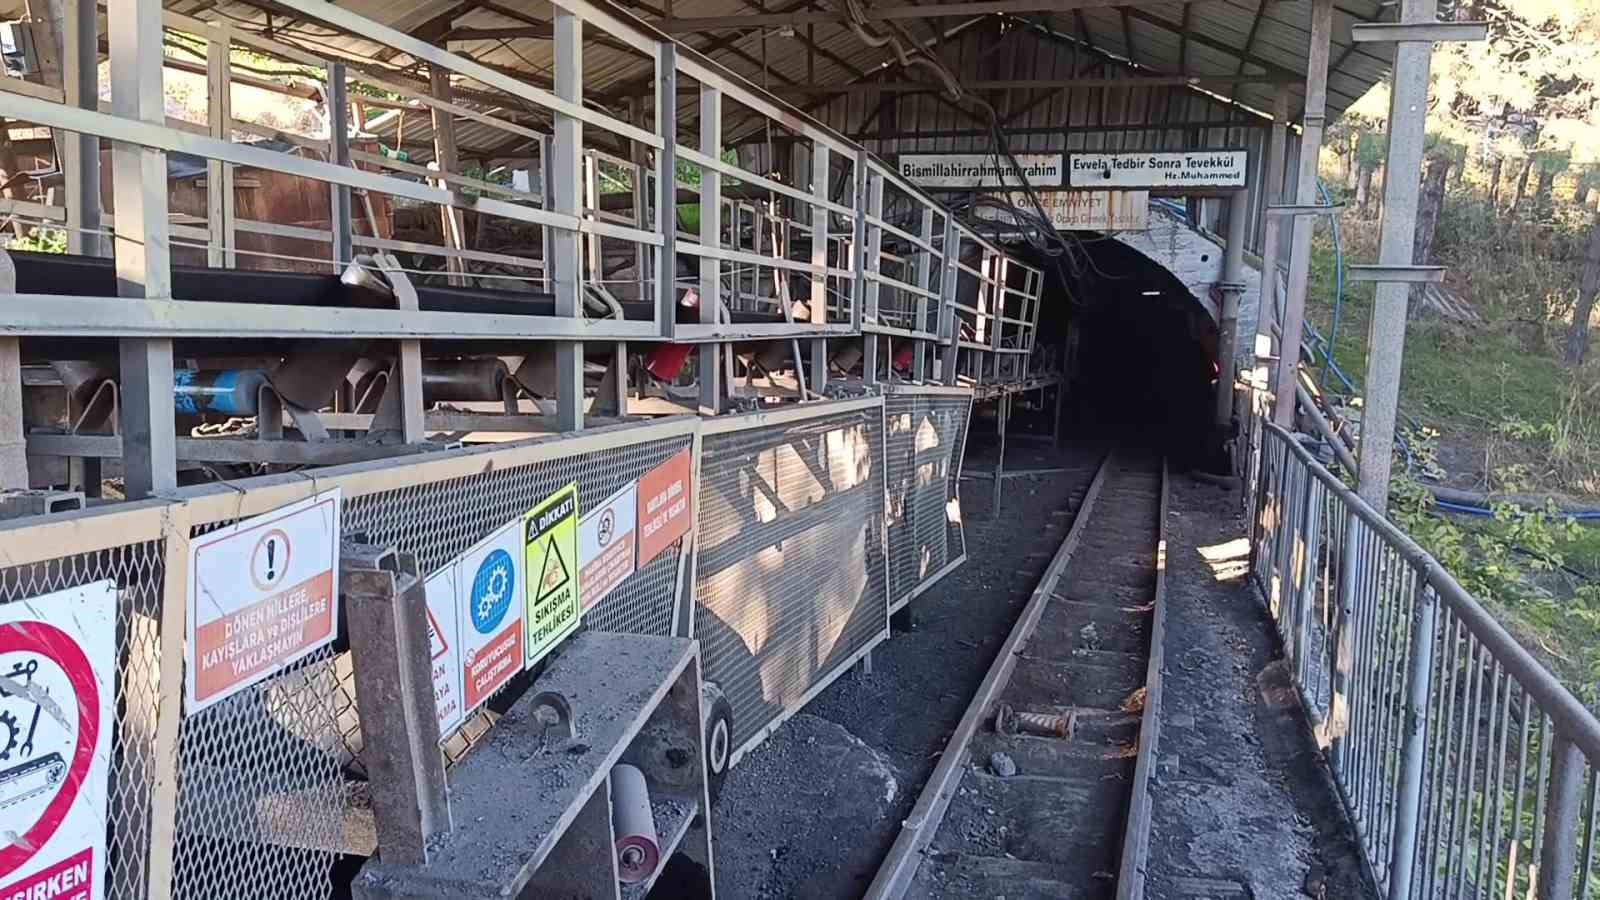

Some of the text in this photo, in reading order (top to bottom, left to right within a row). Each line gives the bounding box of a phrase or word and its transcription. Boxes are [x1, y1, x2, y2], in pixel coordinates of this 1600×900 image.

[903, 162, 1056, 177] Bismillahirrahmanirahim
[1073, 156, 1233, 169] Evvela Tedbir Sonra Tevekkül
[1165, 171, 1240, 180] Hz.Muhammed
[224, 588, 307, 639] DÖNEN MİLLERE
[532, 600, 574, 645] TEHLİKESİ
[535, 588, 571, 624] SIKIŞMA
[202, 628, 265, 671] KAYIŞLARA
[232, 629, 304, 676] YAKLAŞMAYIN
